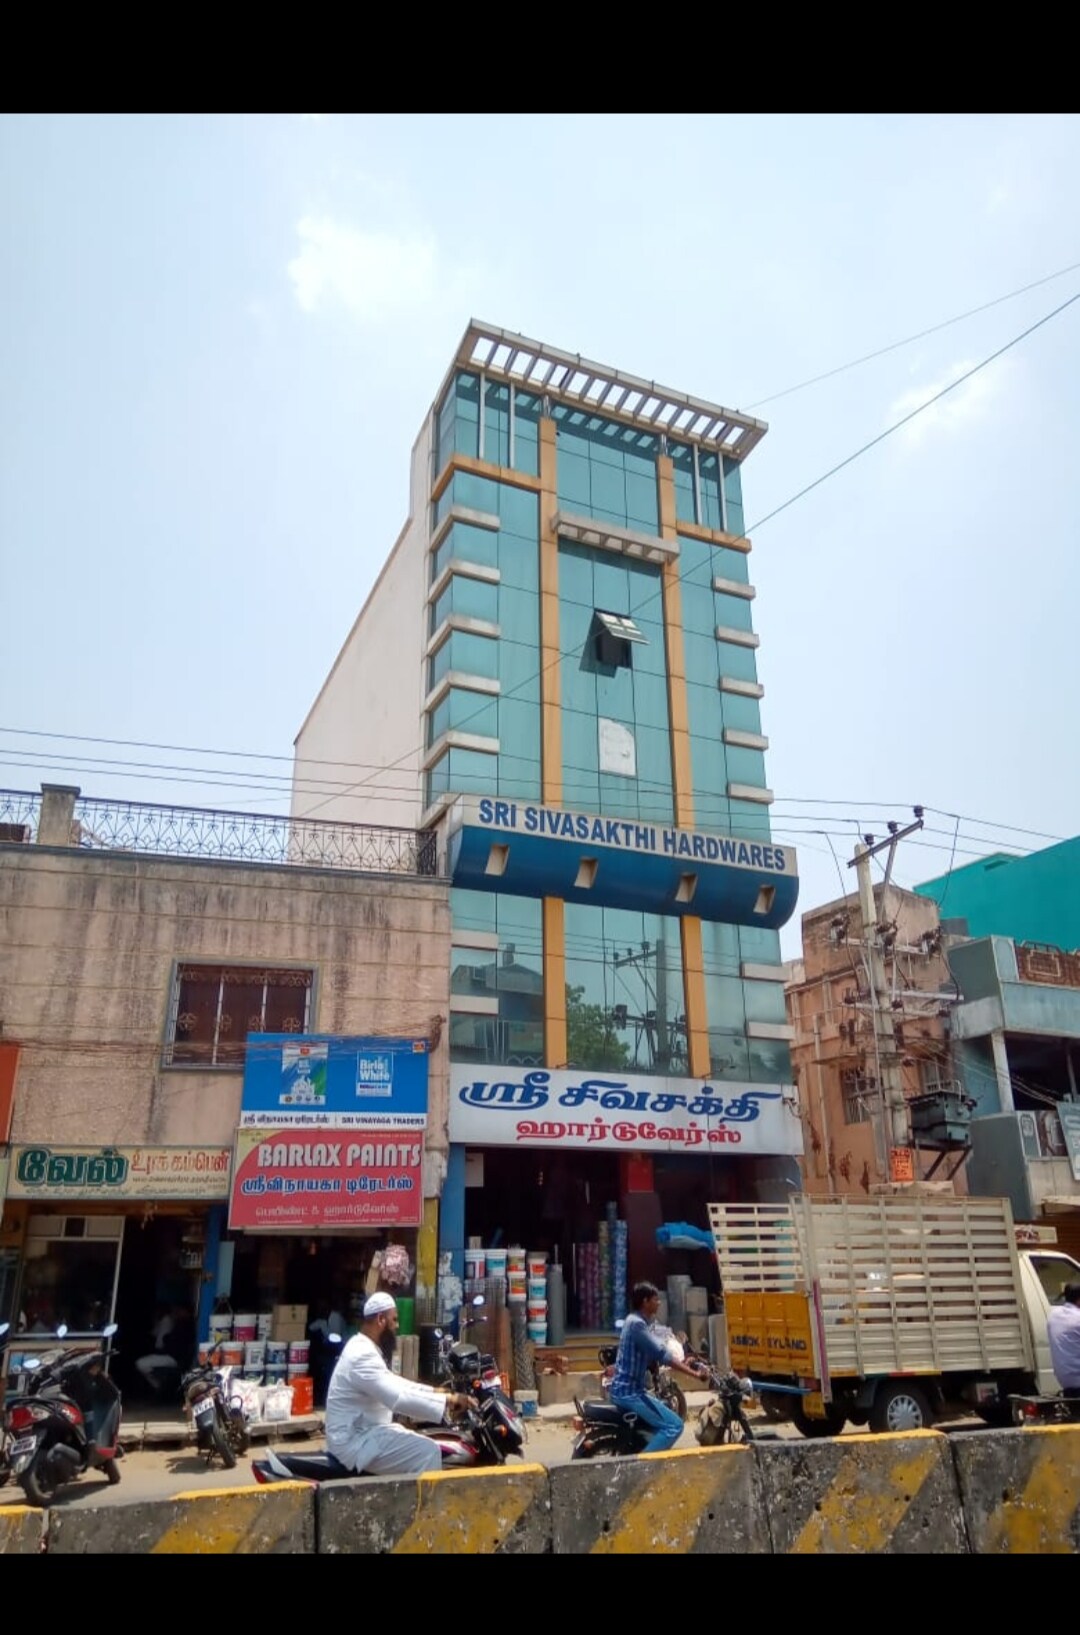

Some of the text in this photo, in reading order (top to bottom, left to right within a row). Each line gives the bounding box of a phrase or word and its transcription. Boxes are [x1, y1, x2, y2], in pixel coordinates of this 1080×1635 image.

[479, 798, 786, 872] SRI SIVASAKTHI HARDWARES
[557, 1080, 783, 1123] சிவசக்தி
[341, 1116, 425, 1126] SRI VINAYAGA TRADERS
[516, 1117, 742, 1146] ஹார்டுவேர்ஸ்
[16, 1147, 129, 1186] வேல்
[257, 1143, 422, 1168] BARLAX PAINTS
[763, 1337, 807, 1351] EYLAND
